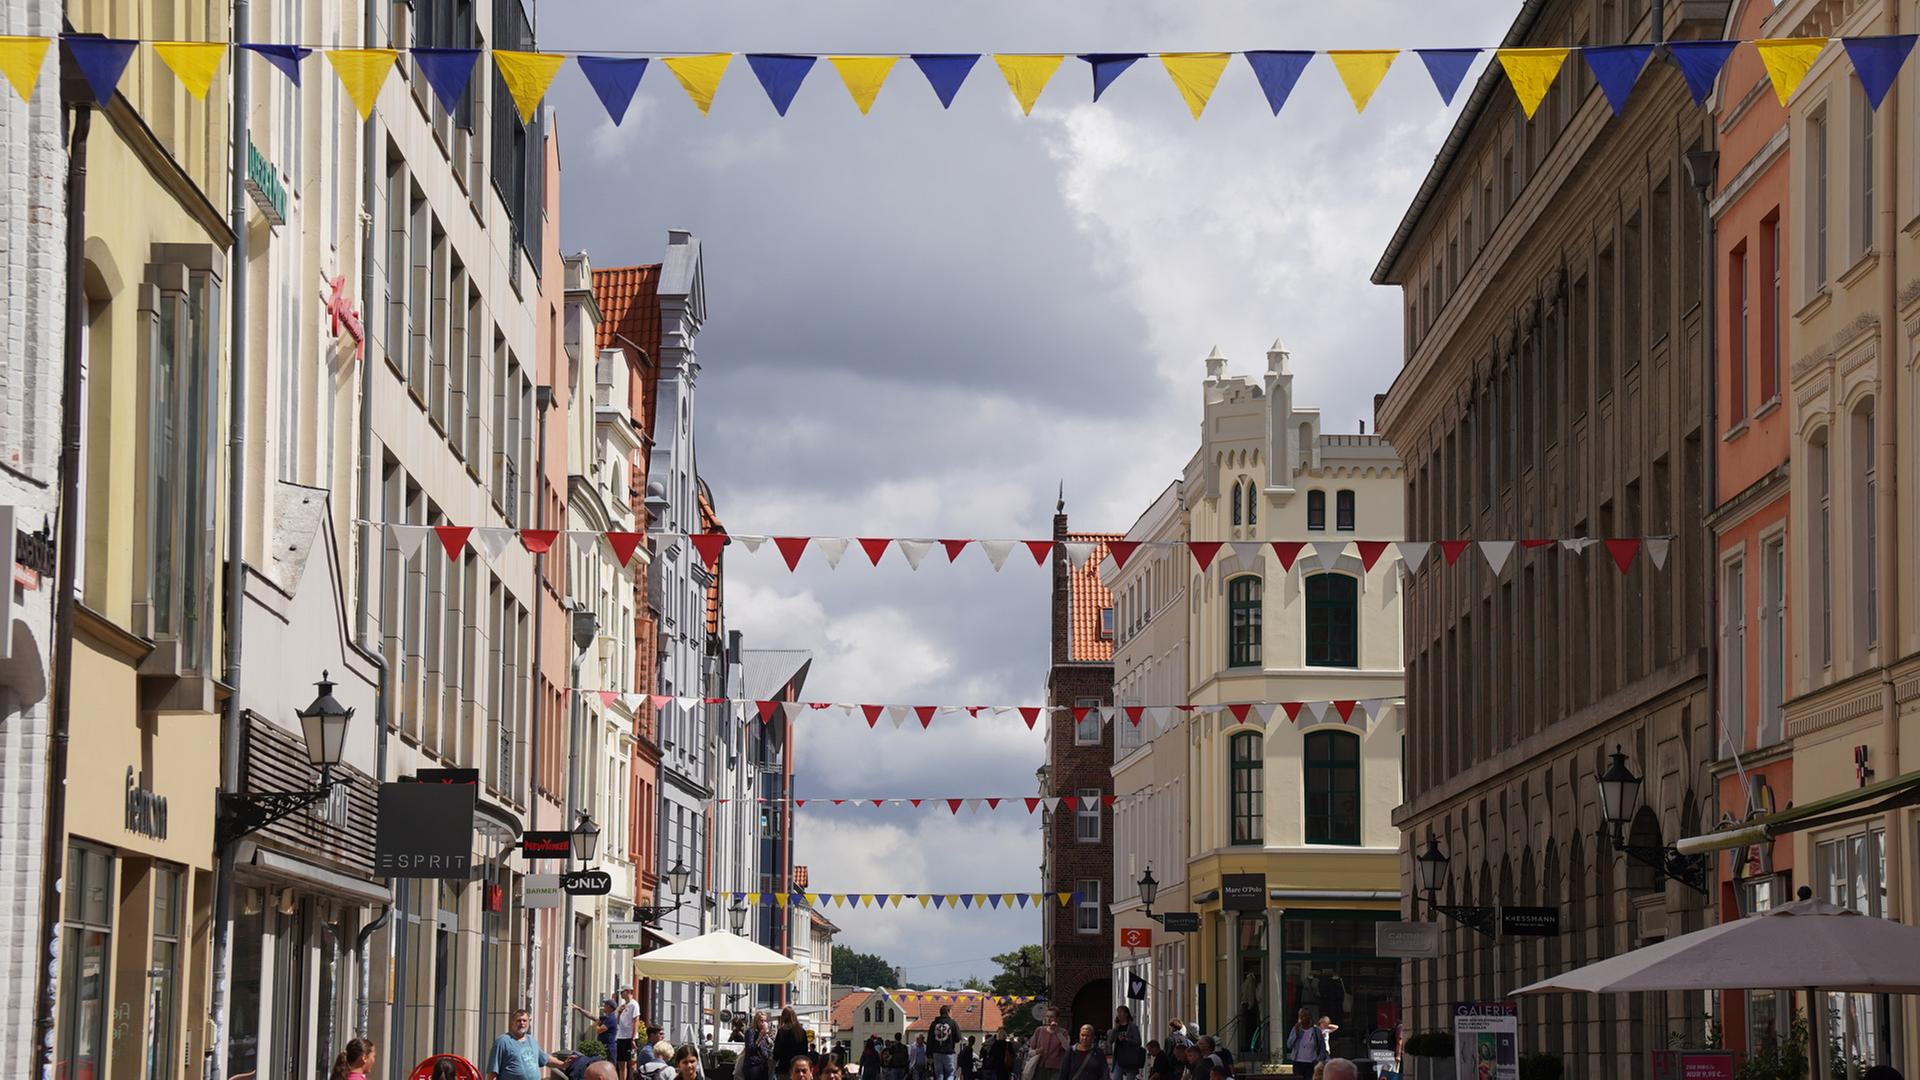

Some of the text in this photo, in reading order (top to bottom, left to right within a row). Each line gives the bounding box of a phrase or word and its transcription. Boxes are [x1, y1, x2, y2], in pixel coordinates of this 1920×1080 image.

[383, 854, 464, 868] ESPRIT
[567, 878, 608, 889] ONLY
[1457, 1005, 1512, 1016] GALERIE
